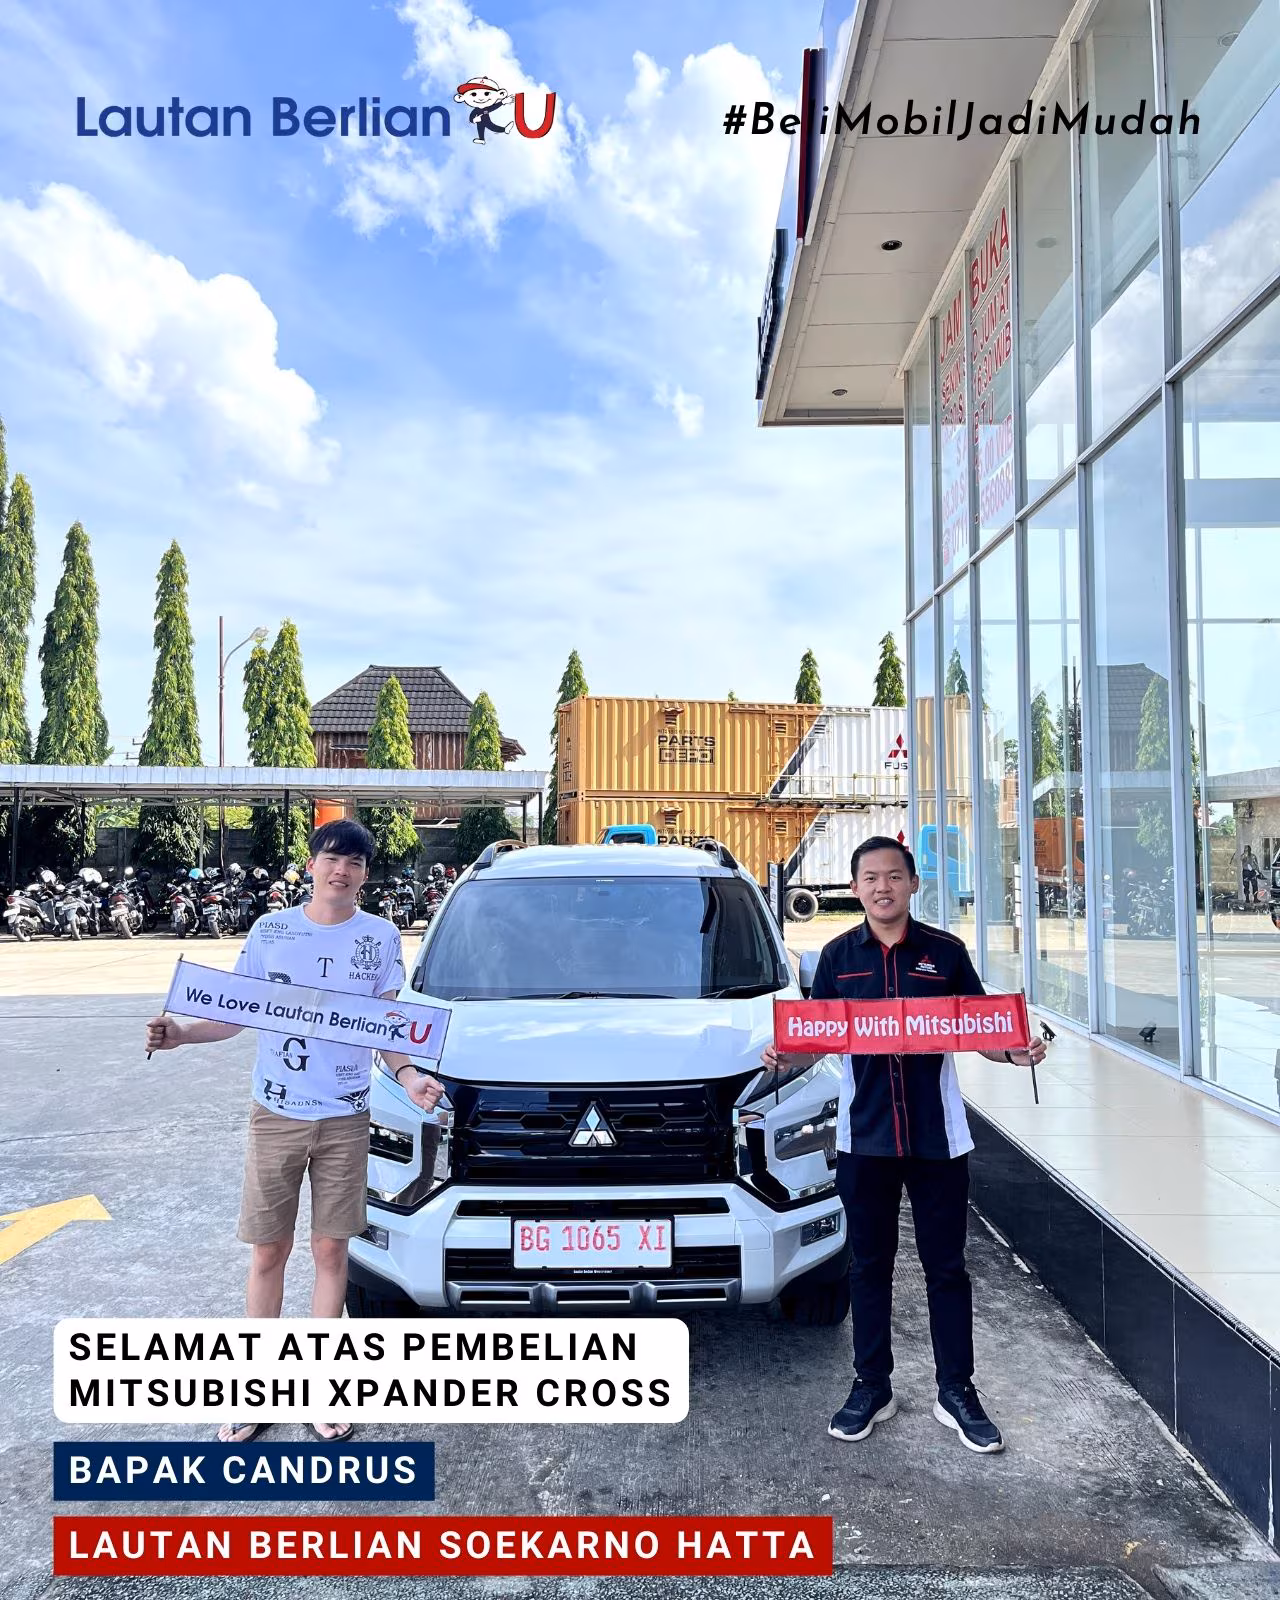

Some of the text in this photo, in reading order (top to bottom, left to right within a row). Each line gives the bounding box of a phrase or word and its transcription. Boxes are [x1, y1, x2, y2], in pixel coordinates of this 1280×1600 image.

[940, 207, 1010, 364] JAM BUKA
[993, 319, 1012, 372] WIB
[658, 735, 716, 747] PARTS
[884, 761, 908, 770] FUS
[317, 957, 334, 978] T
[185, 985, 213, 1006] We
[217, 991, 261, 1014] Love
[264, 1000, 325, 1025] Lautan
[328, 1011, 388, 1037] Berlian
[788, 1010, 1014, 1038] Happy With Mitsubishi
[519, 1224, 667, 1252] BG 1065 XI
